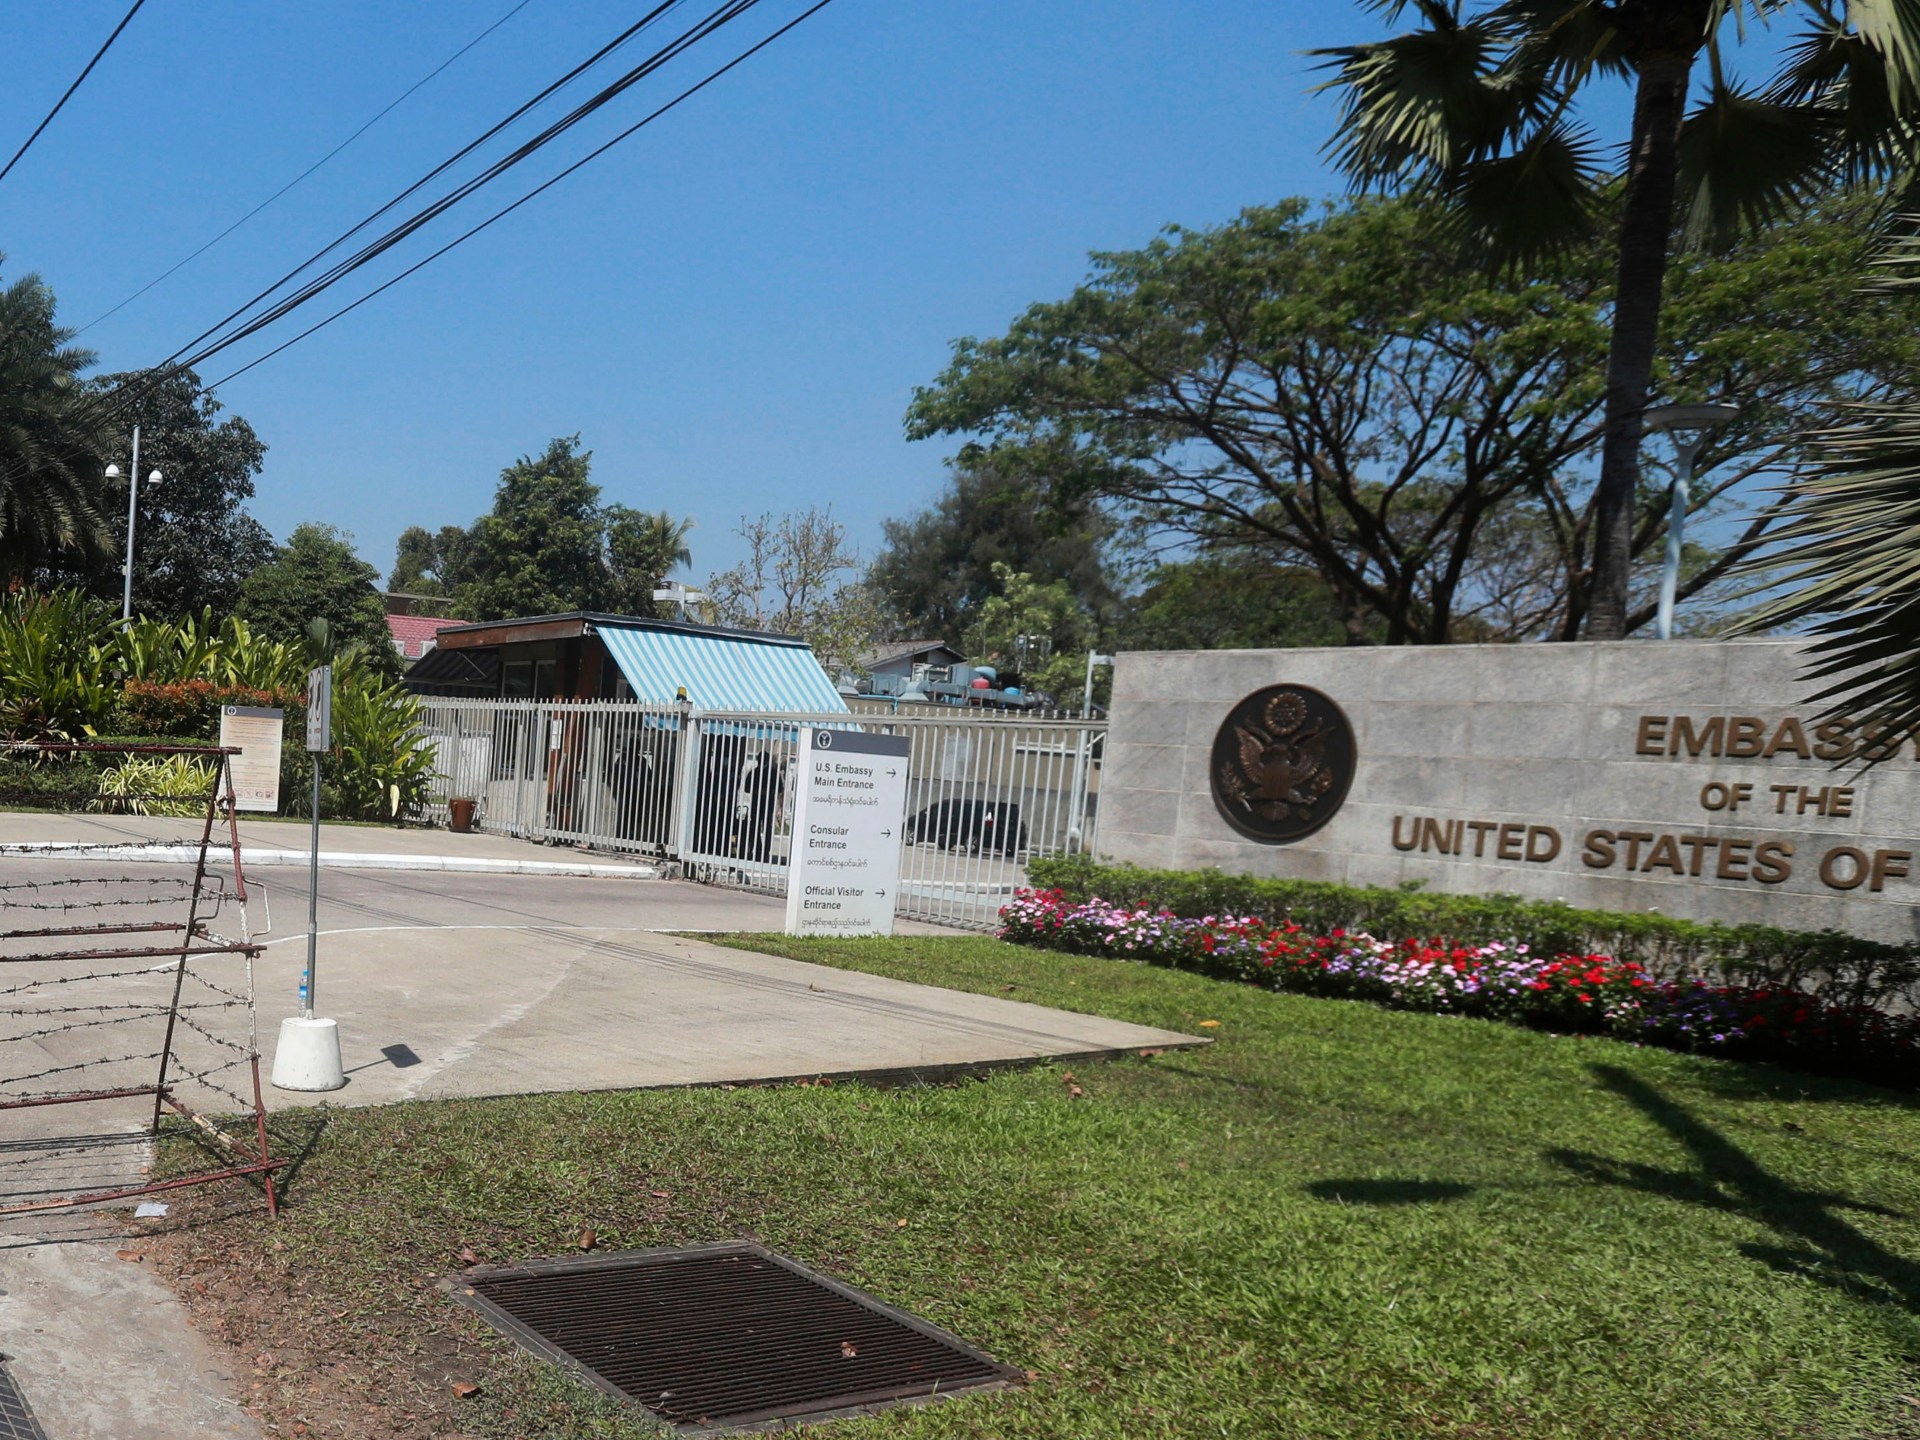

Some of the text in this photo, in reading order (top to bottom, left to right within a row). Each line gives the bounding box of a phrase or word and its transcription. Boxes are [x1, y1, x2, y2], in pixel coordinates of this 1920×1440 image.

[815, 762, 873, 777] U.S. Embassy
[814, 776, 874, 790] Main Entrance
[1699, 781, 1855, 818] OF THE
[810, 824, 849, 836] Consular
[809, 838, 847, 850] Entrance
[1392, 815, 1912, 892] UNITED STATES OF
[804, 885, 865, 897] Official Visitor
[803, 899, 842, 910] Entrance
